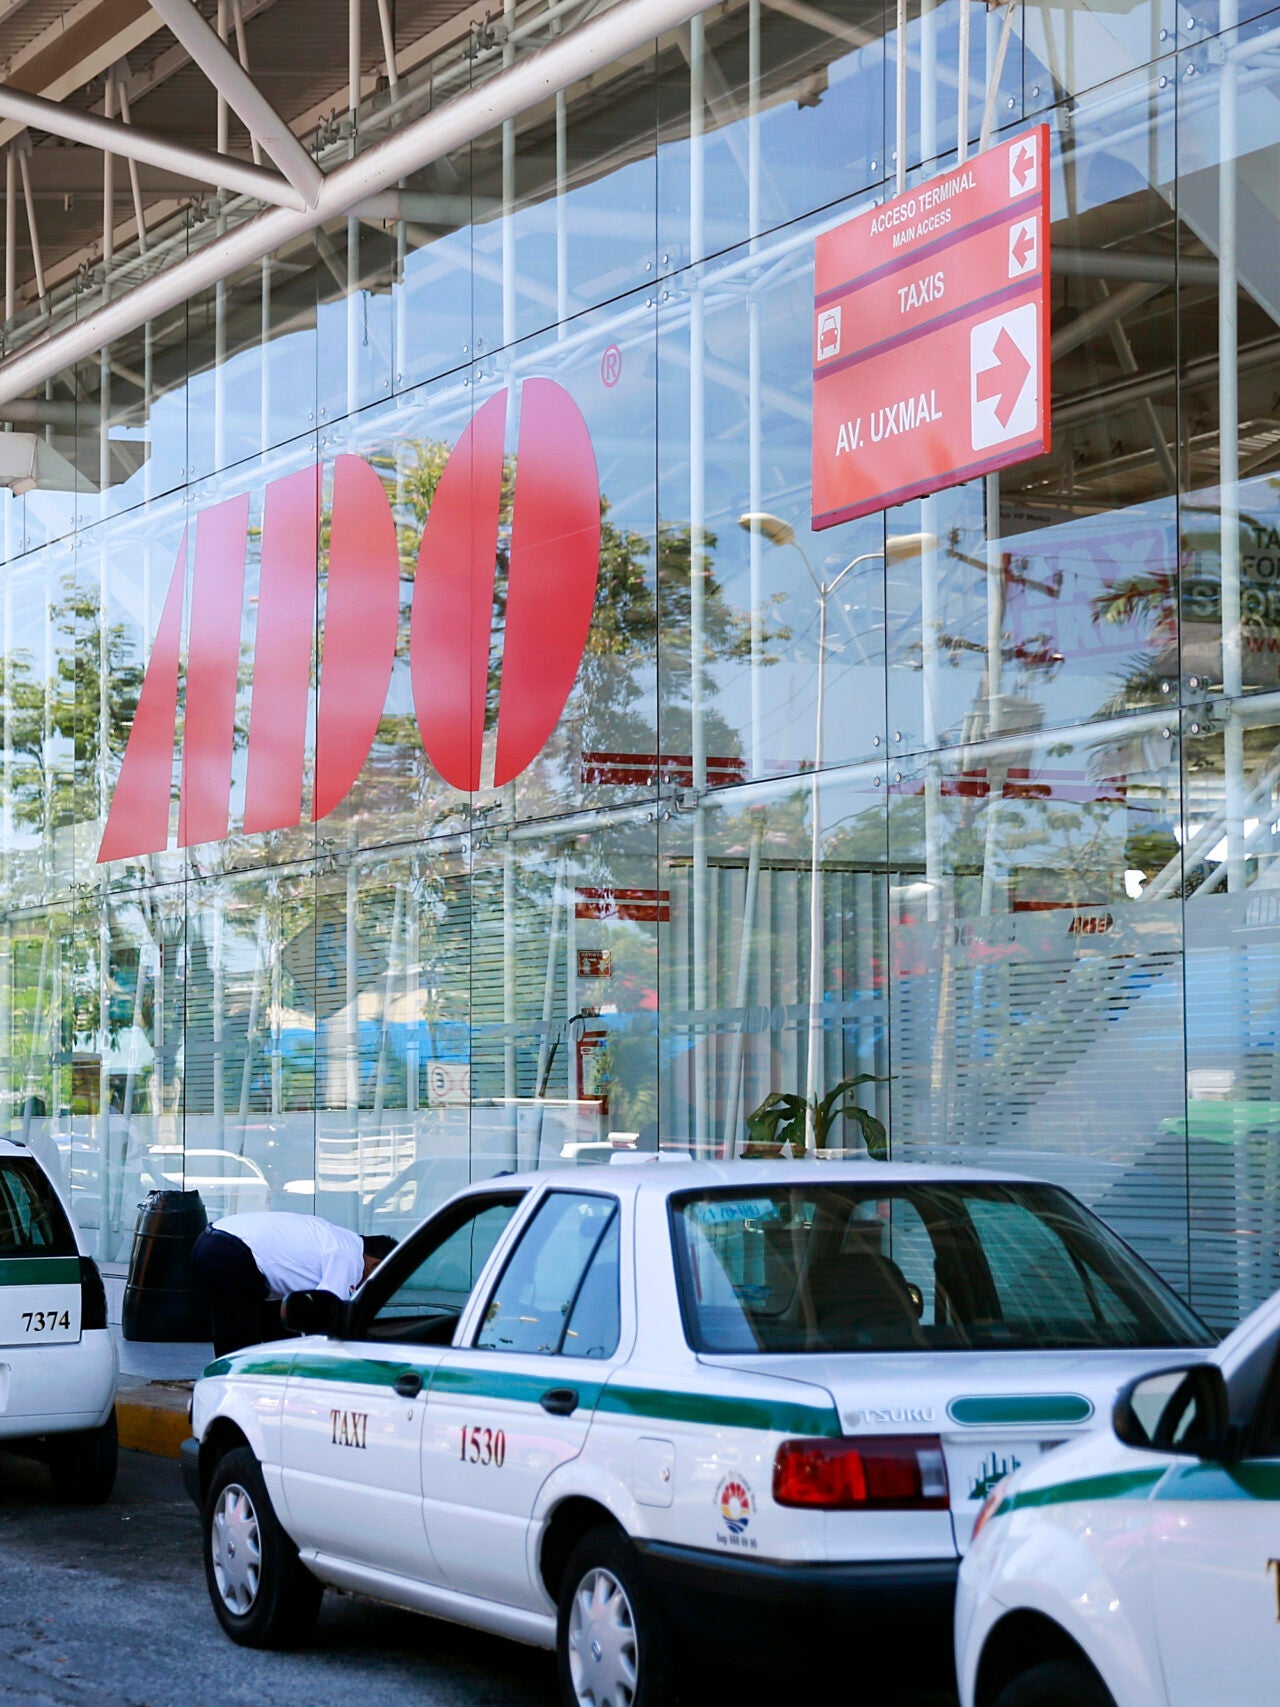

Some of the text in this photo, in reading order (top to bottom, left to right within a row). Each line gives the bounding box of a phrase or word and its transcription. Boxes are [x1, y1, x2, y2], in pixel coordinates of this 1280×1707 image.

[870, 170, 977, 237] ACCESO TERMINAL
[892, 208, 952, 249] MAIN ACCESS
[897, 271, 945, 314] TAXIS
[835, 389, 943, 456] AV. UXMAL
[97, 377, 602, 863] ADO
[21, 1310, 71, 1332] 7374
[330, 1409, 369, 1449] TAXI
[860, 1407, 937, 1424] TSURU
[459, 1424, 507, 1468] 1530
